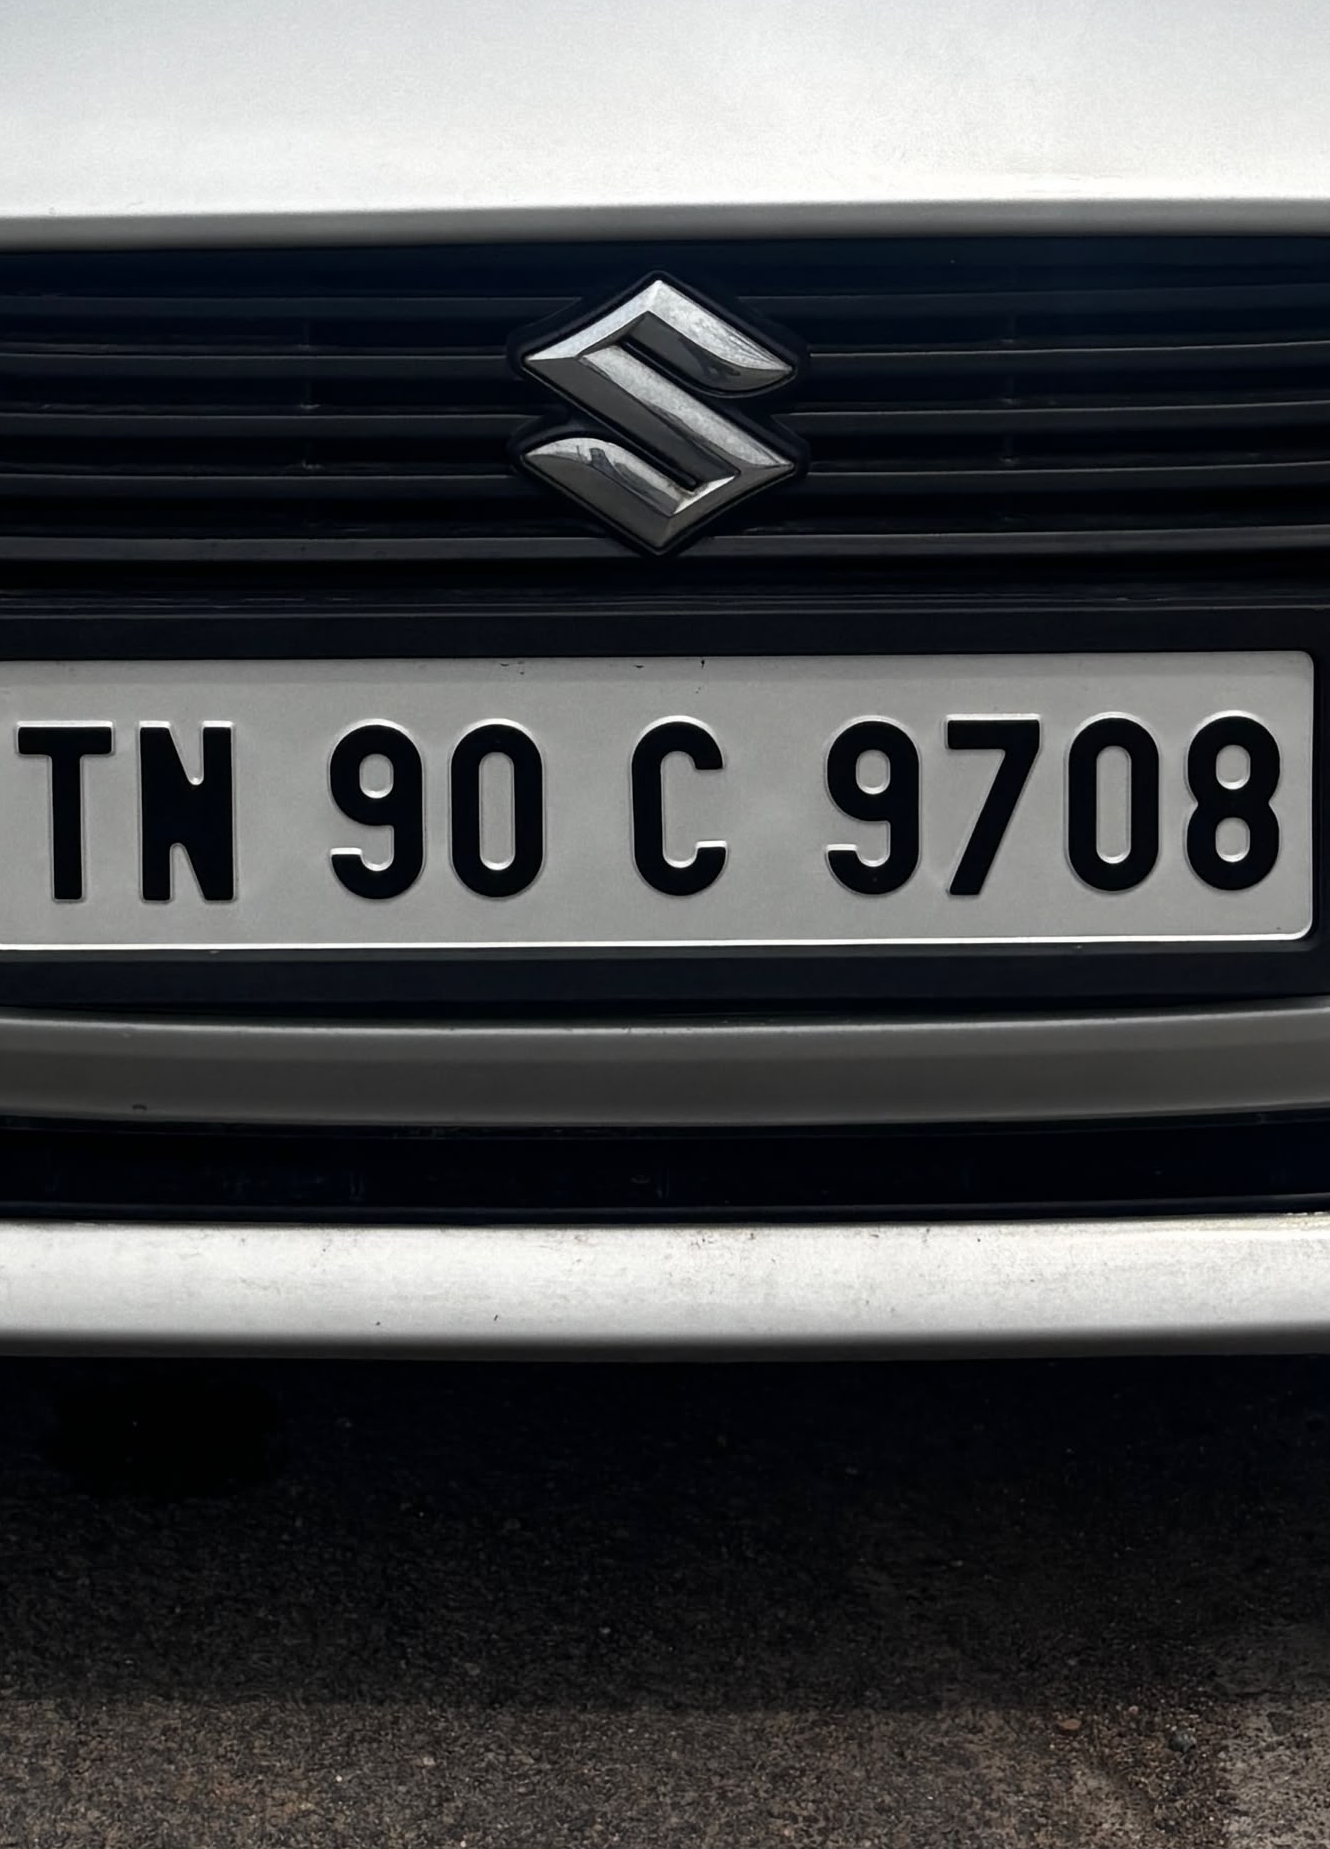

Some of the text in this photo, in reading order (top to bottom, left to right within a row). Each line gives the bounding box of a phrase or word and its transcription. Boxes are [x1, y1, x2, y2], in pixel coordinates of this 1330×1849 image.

[16, 713, 1282, 904] TN 90 C 9708
